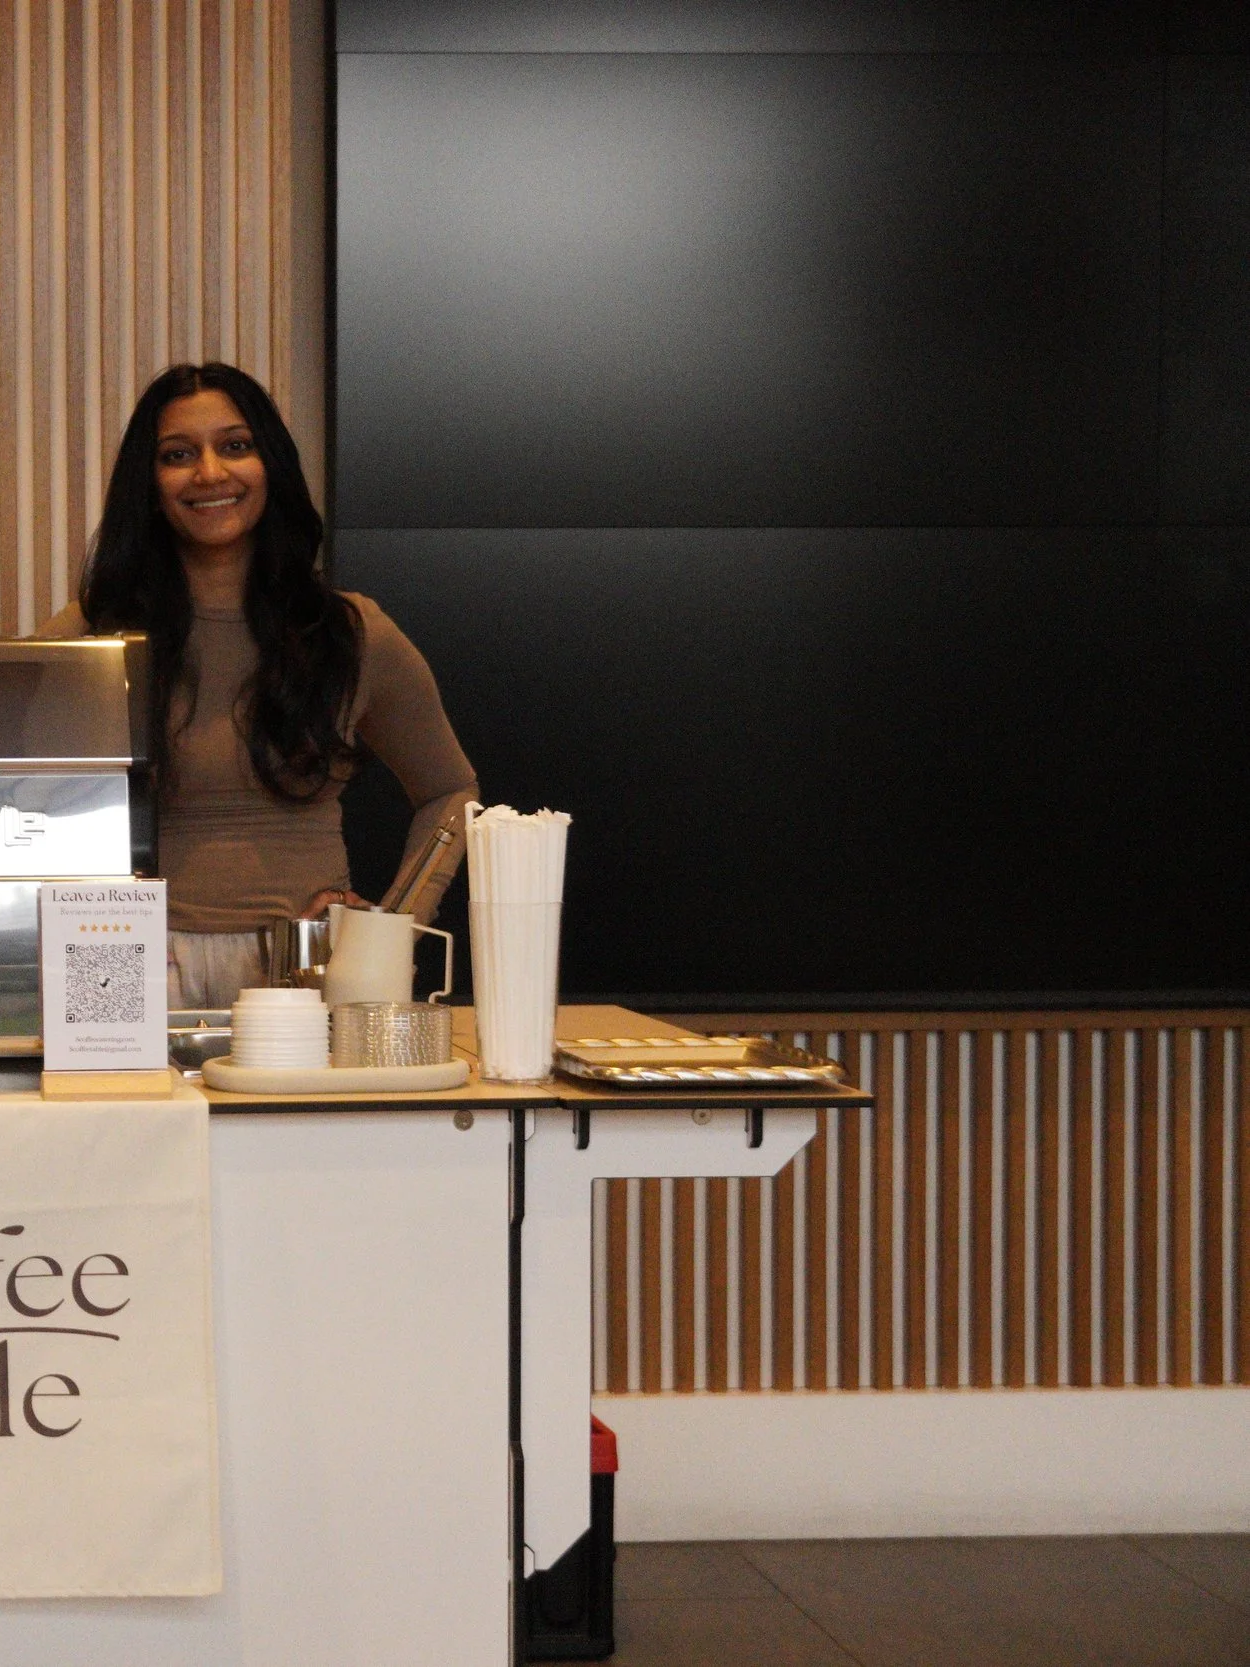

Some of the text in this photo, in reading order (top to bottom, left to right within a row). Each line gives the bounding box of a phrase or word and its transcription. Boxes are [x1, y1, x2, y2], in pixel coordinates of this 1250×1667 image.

[53, 889, 158, 902] Leave a Review
[60, 908, 92, 916] Reviews
[109, 908, 121, 916] the
[122, 908, 137, 916] best
[140, 908, 153, 917] tips
